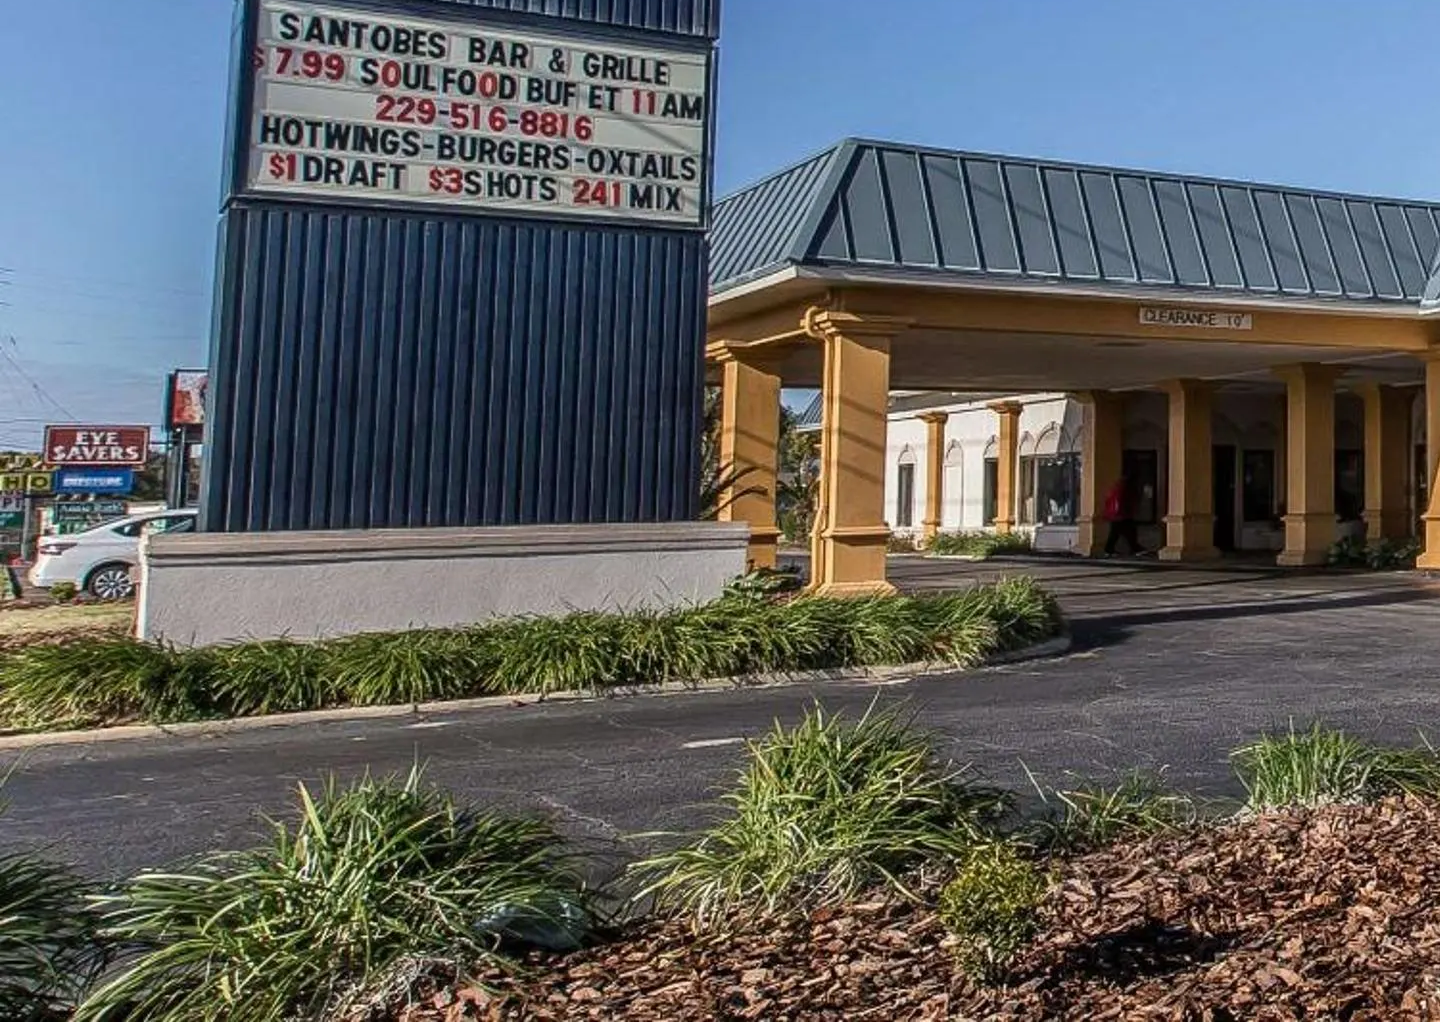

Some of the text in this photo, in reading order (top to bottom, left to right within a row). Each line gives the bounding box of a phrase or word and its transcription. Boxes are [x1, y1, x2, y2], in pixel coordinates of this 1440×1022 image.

[280, 13, 670, 86] SANTOBES BAR & GRILLE
[376, 94, 593, 142] 229-516-8816
[572, 178, 621, 207] 241
[629, 183, 683, 211] MIX
[1144, 309, 1217, 326] CLEARANCE
[75, 430, 119, 445] EYE
[52, 444, 141, 461] SAVERS
